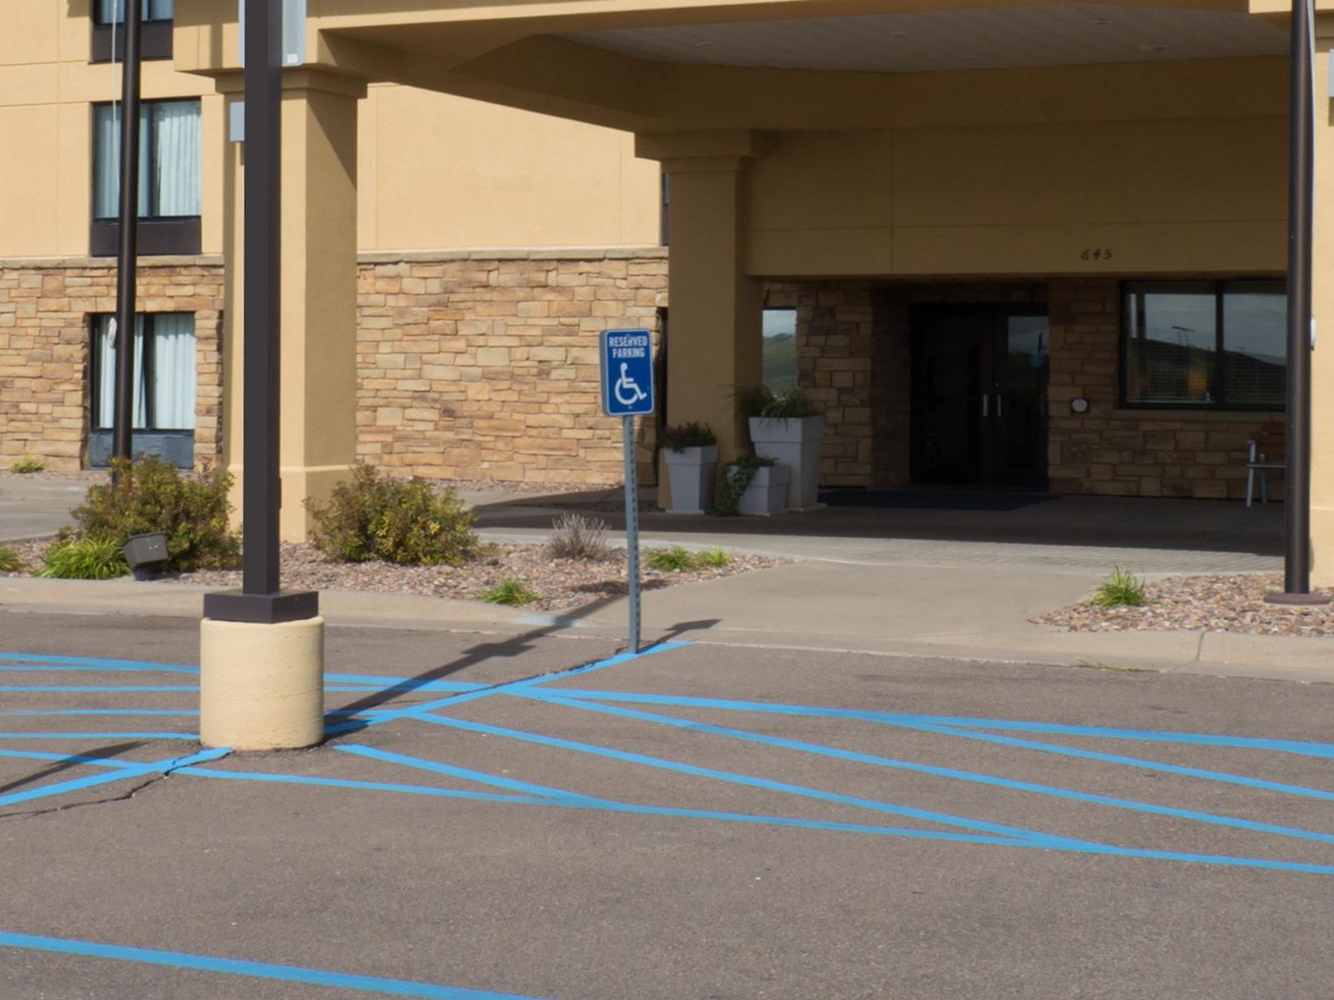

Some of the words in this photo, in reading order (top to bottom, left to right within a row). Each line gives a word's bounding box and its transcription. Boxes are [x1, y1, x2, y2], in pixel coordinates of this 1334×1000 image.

[1081, 247, 1112, 260] 645
[609, 336, 648, 347] RESERVED
[613, 348, 645, 358] PARKING
